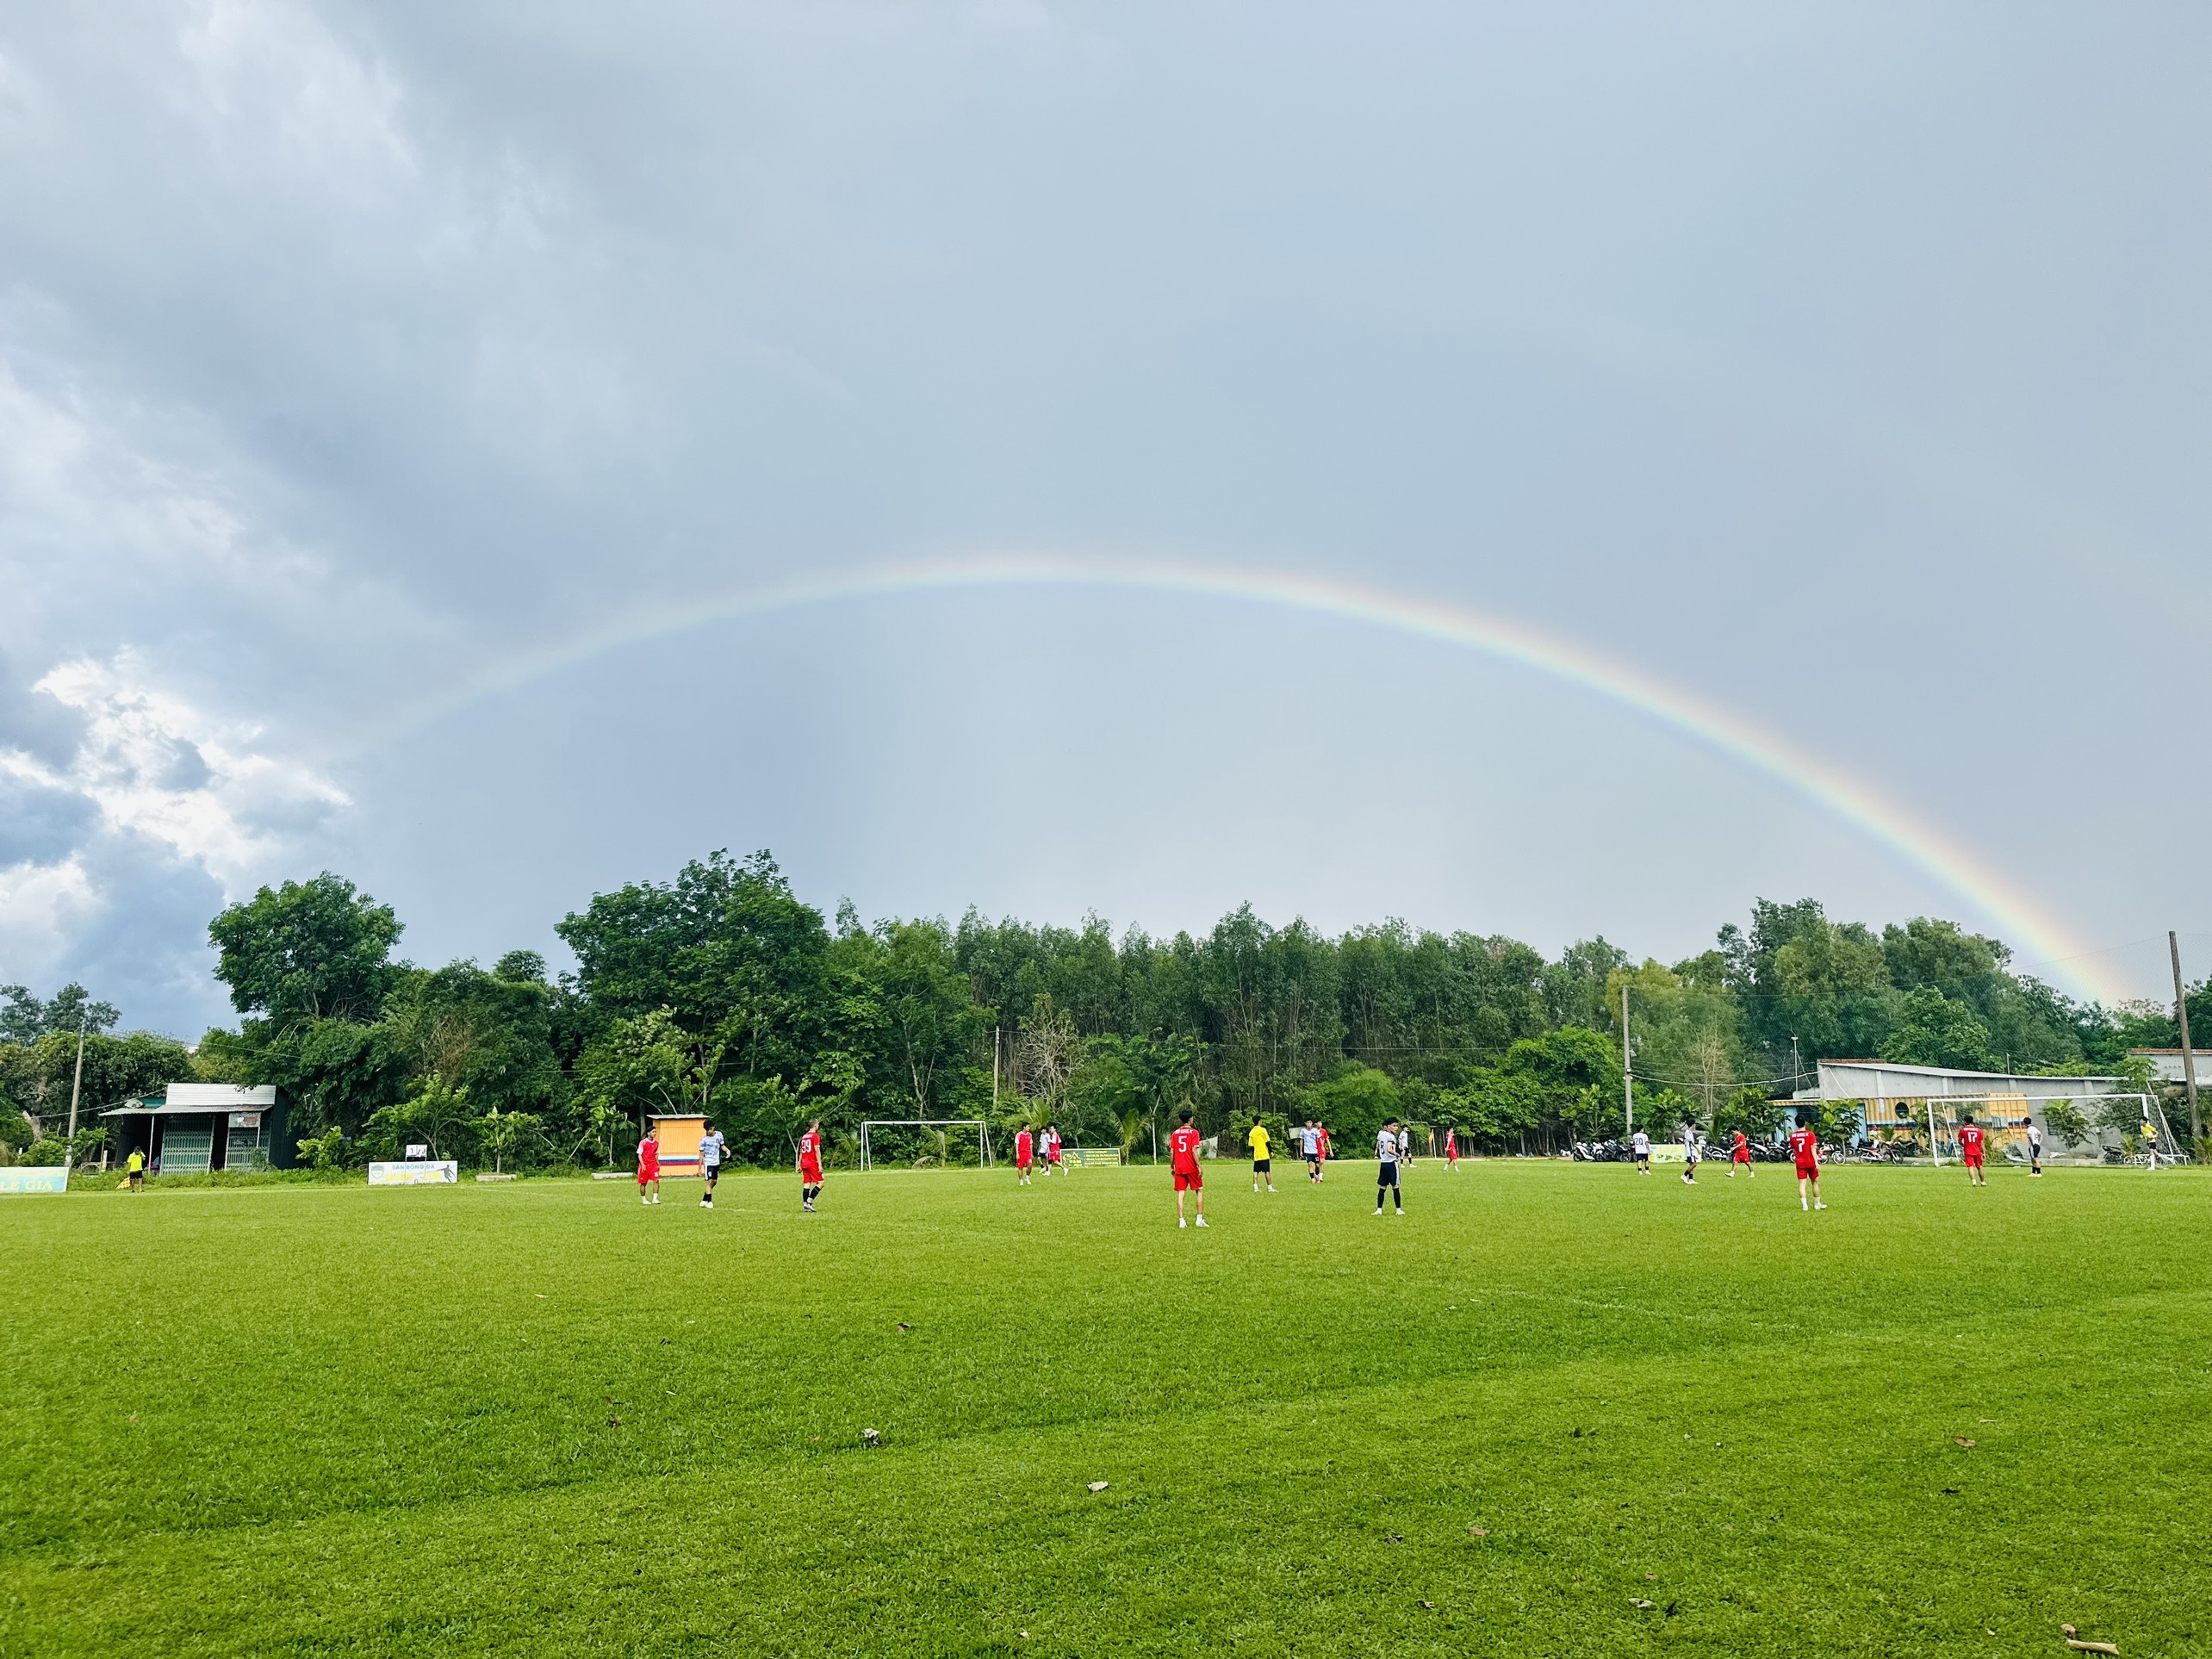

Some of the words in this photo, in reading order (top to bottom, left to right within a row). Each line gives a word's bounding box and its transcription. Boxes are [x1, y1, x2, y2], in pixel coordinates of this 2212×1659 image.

[1177, 1135, 1187, 1153] 5
[1634, 1137, 1643, 1146] 20
[1967, 1132, 1978, 1142] 17
[801, 1139, 811, 1153] 39
[1380, 1140, 1385, 1155] 8
[1796, 1138, 1805, 1153] 7
[25, 1180, 53, 1190] GIA
